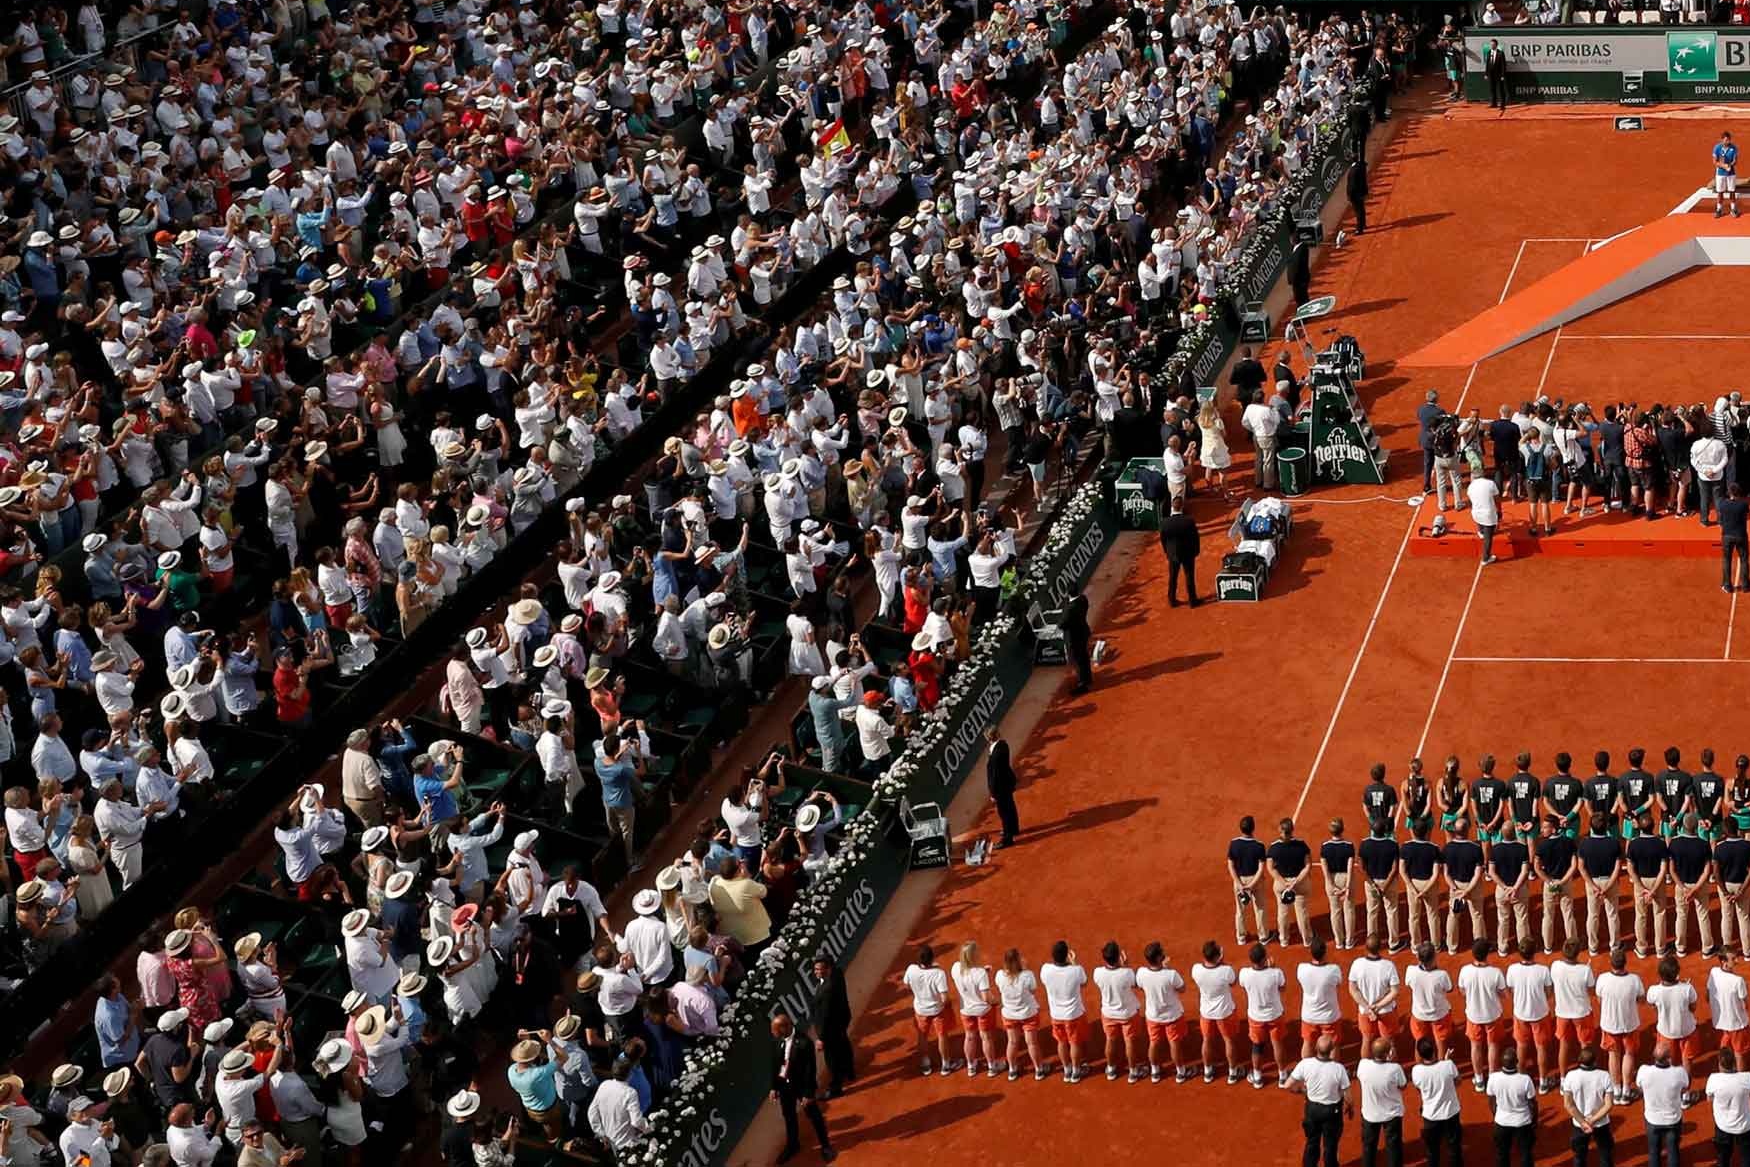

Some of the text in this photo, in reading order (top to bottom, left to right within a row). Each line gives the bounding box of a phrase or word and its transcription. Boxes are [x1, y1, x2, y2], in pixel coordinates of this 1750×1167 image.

[1511, 44, 1612, 57] BNP PARIBAS
[1516, 85, 1580, 96] BNP PARIBAS
[1694, 85, 1716, 95] BNP
[1247, 244, 1281, 300] LONGINES
[1314, 440, 1367, 477] perrier
[1048, 521, 1104, 609] LONGINES
[1219, 577, 1254, 600] perrier
[934, 675, 1005, 786] LONGINES
